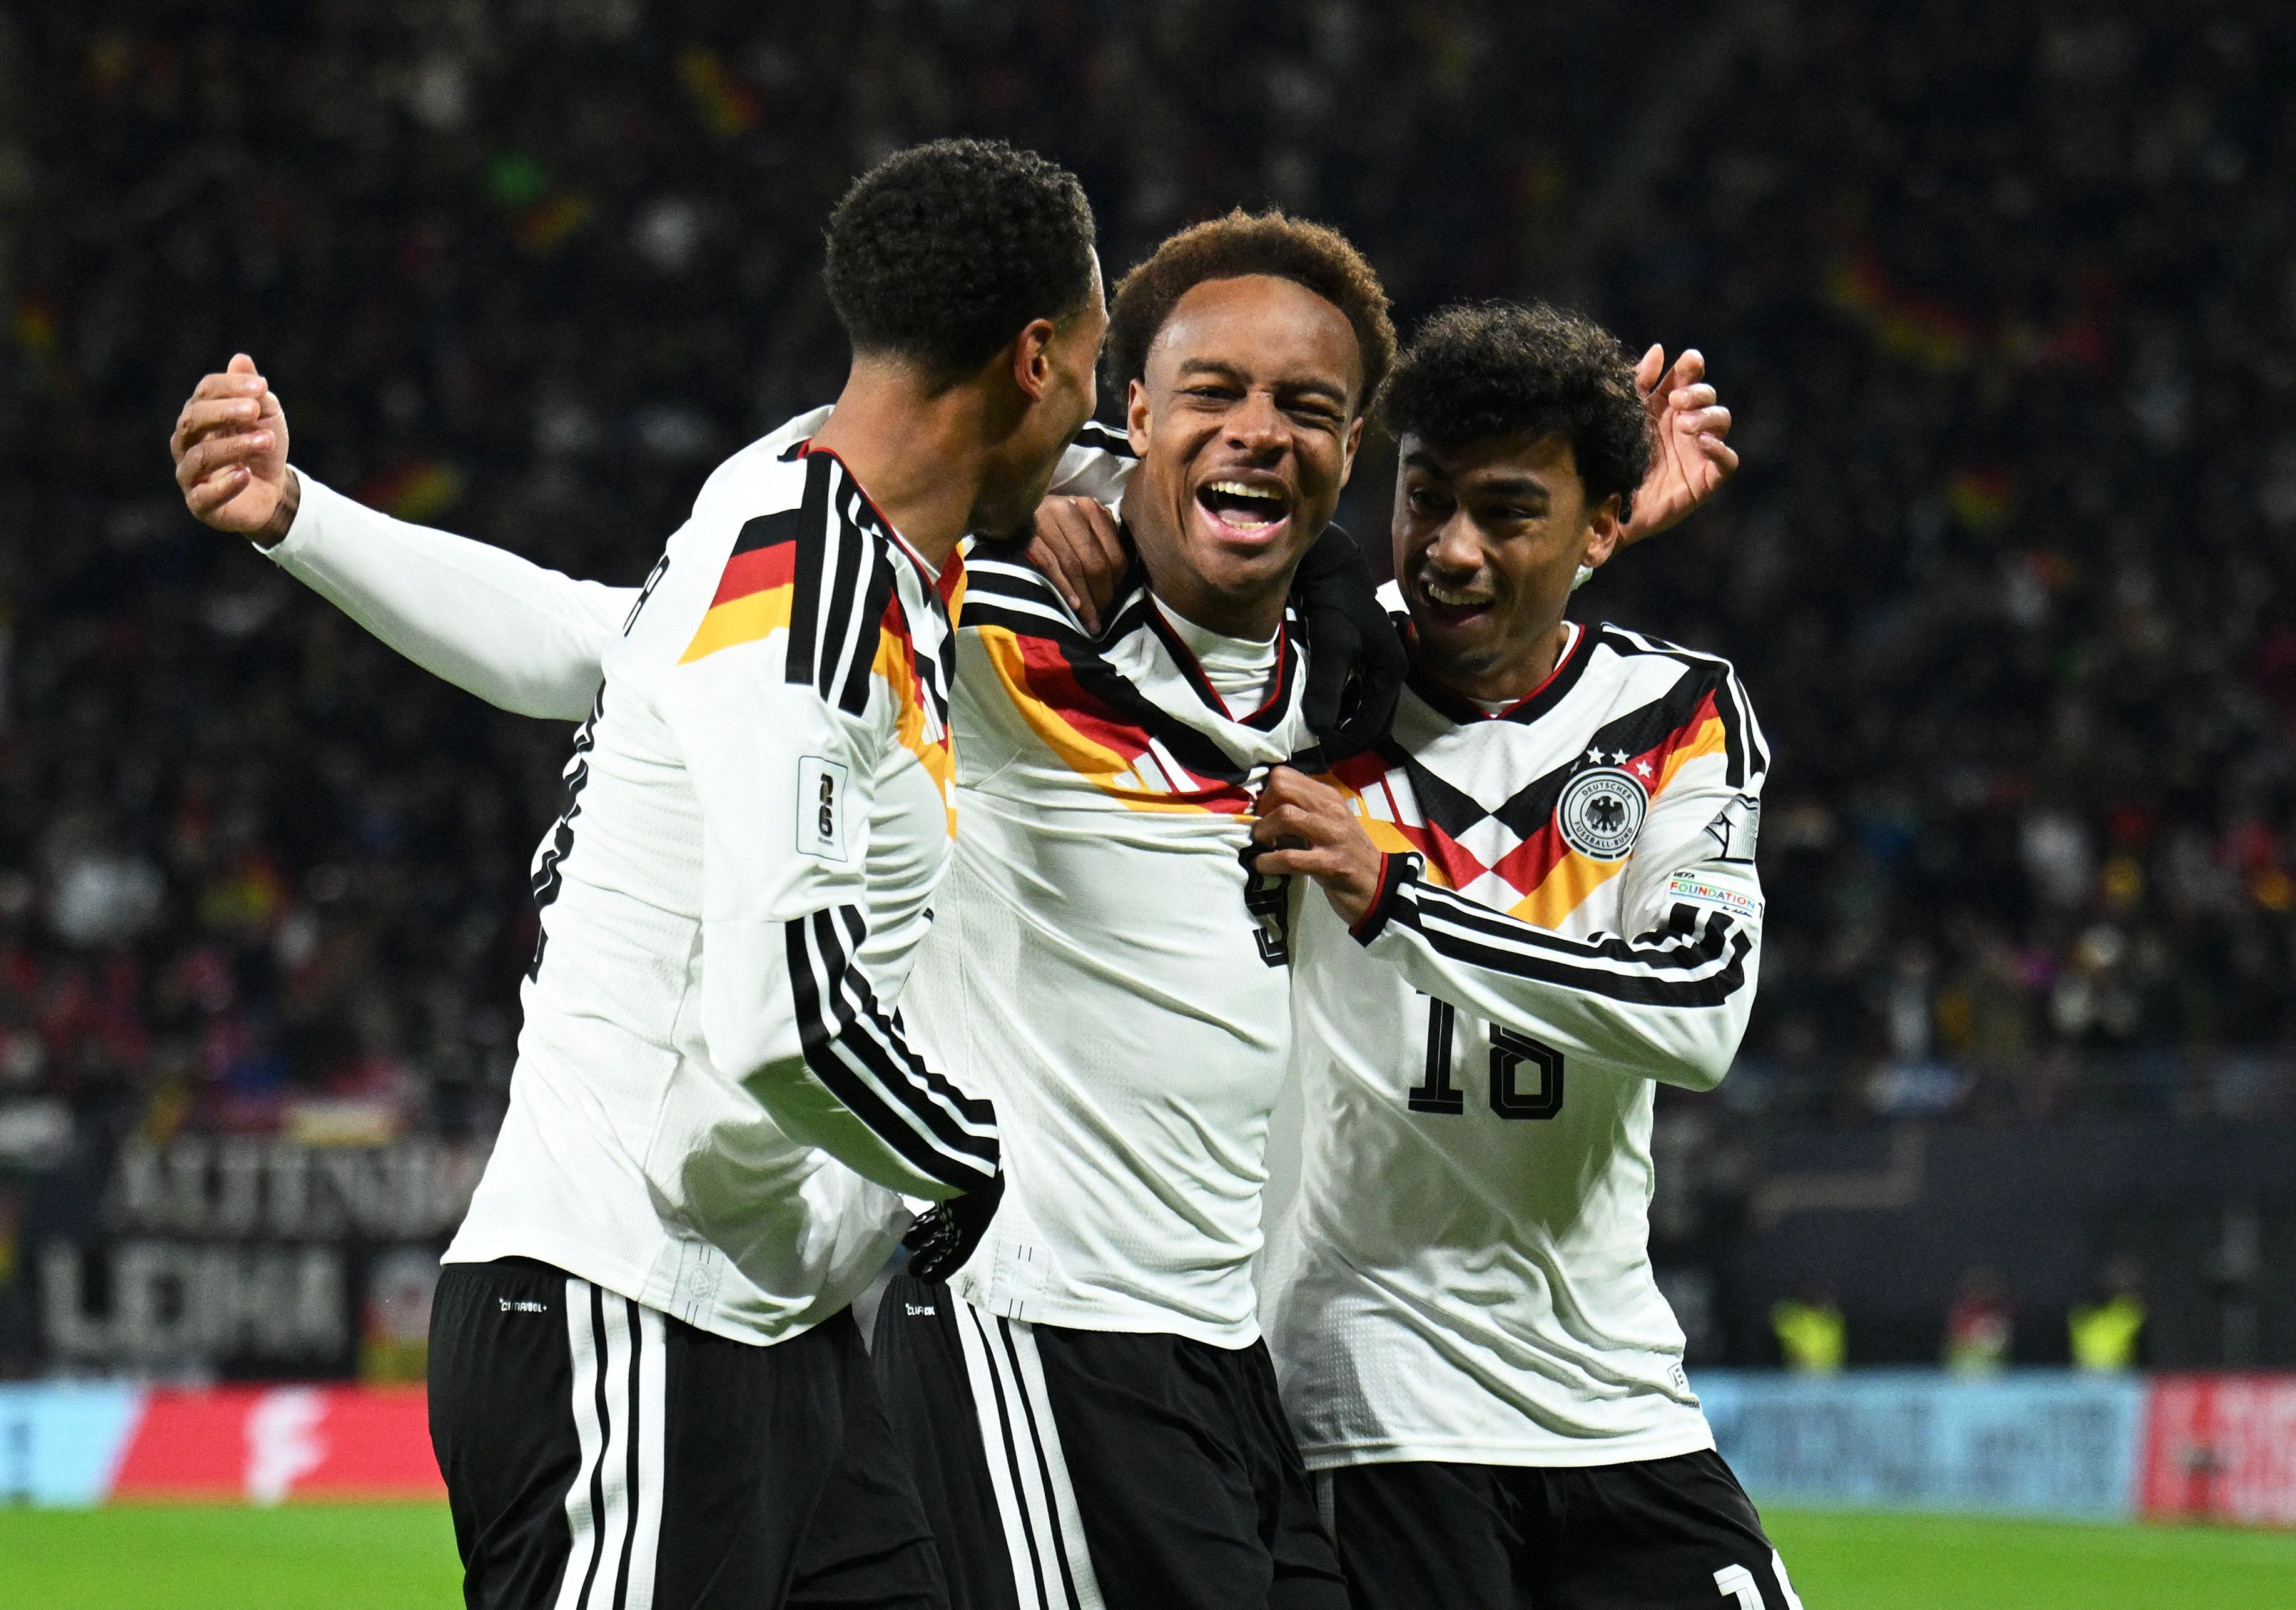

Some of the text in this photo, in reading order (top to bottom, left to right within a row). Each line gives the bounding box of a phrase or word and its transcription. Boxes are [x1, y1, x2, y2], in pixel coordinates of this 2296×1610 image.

[1582, 782, 1632, 800] DEUTSCHER
[1574, 821, 1632, 847] FUSSBALL-BUND
[1670, 881, 1755, 909] FOUNDATION
